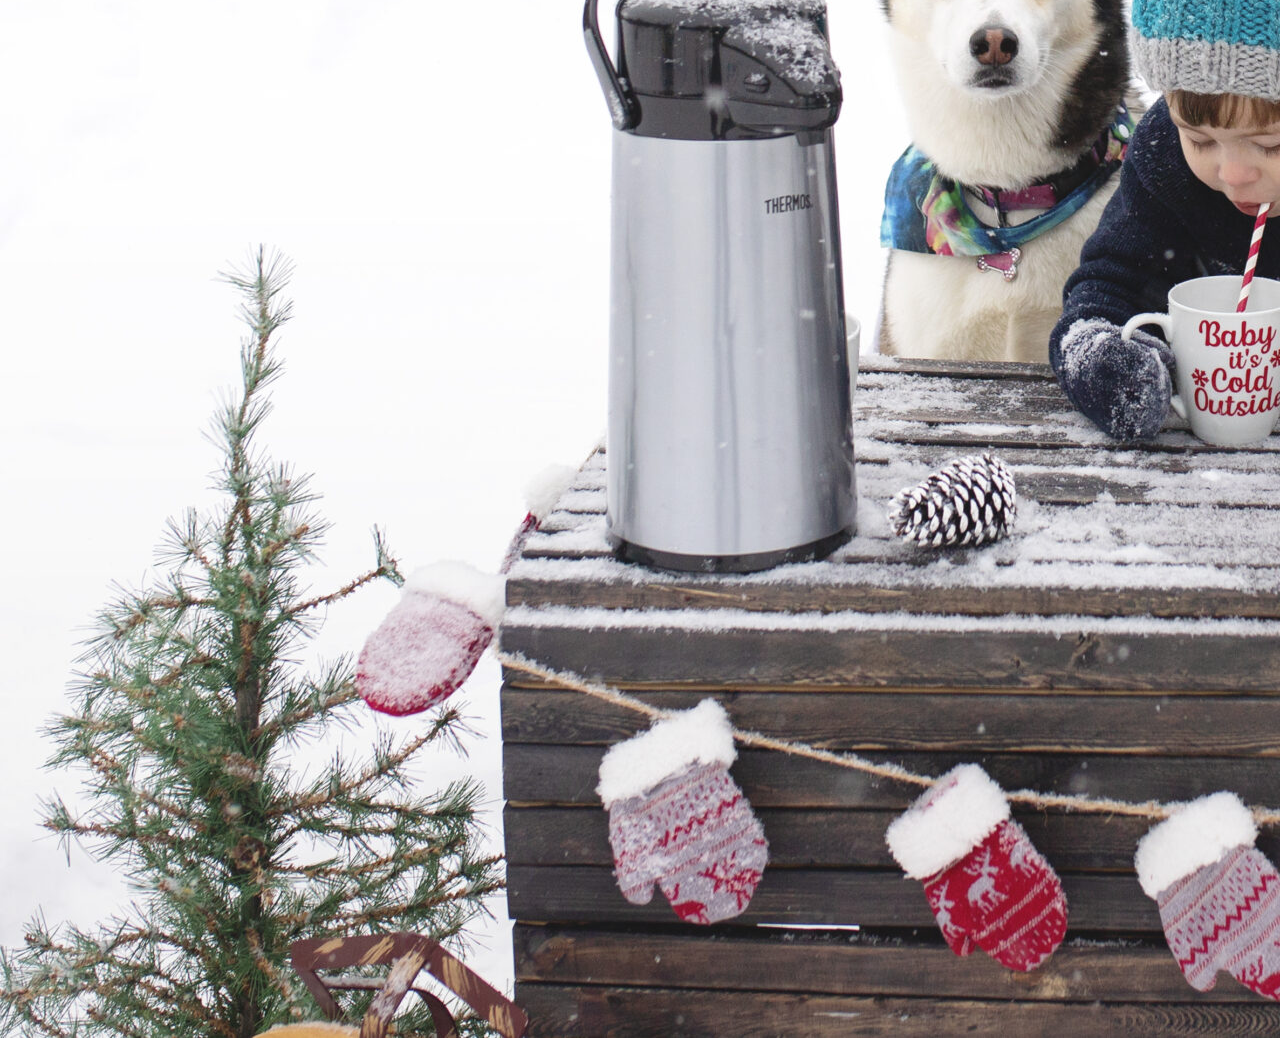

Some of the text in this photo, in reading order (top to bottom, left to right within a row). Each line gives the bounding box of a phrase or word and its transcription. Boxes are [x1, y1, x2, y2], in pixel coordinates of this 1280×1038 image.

[1198, 319, 1277, 355] Baby
[1229, 348, 1263, 370] it's
[1211, 365, 1274, 394] Cold
